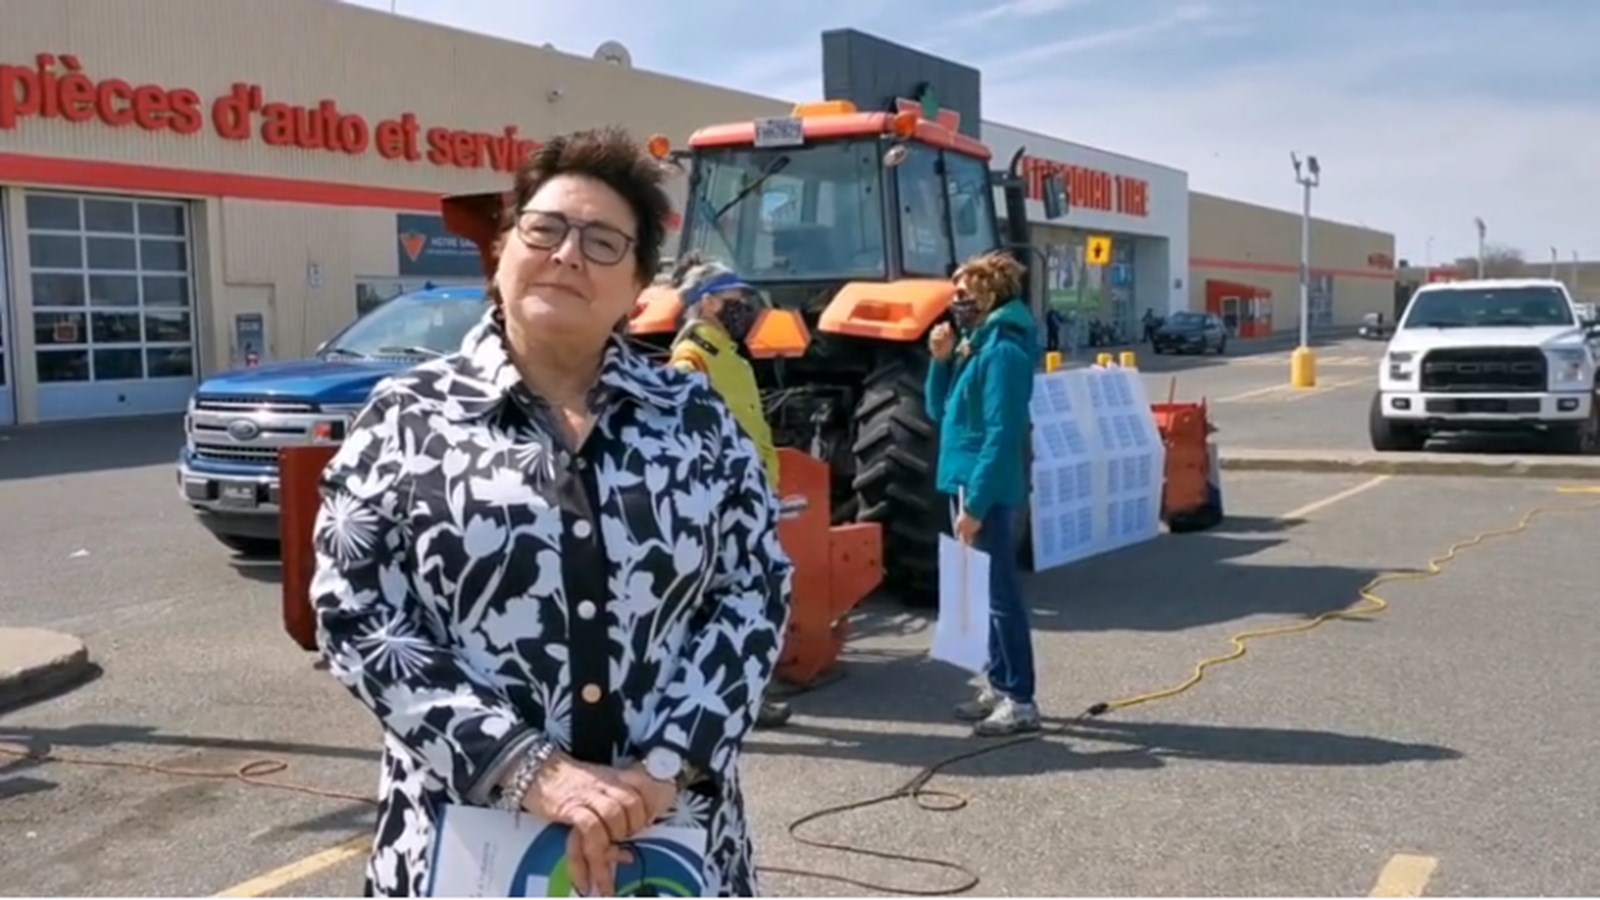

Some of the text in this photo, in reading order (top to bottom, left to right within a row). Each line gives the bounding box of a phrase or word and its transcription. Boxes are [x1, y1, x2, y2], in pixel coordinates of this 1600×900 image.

[0, 53, 203, 132] pièces
[212, 83, 369, 154] d'auto
[376, 113, 421, 162] et
